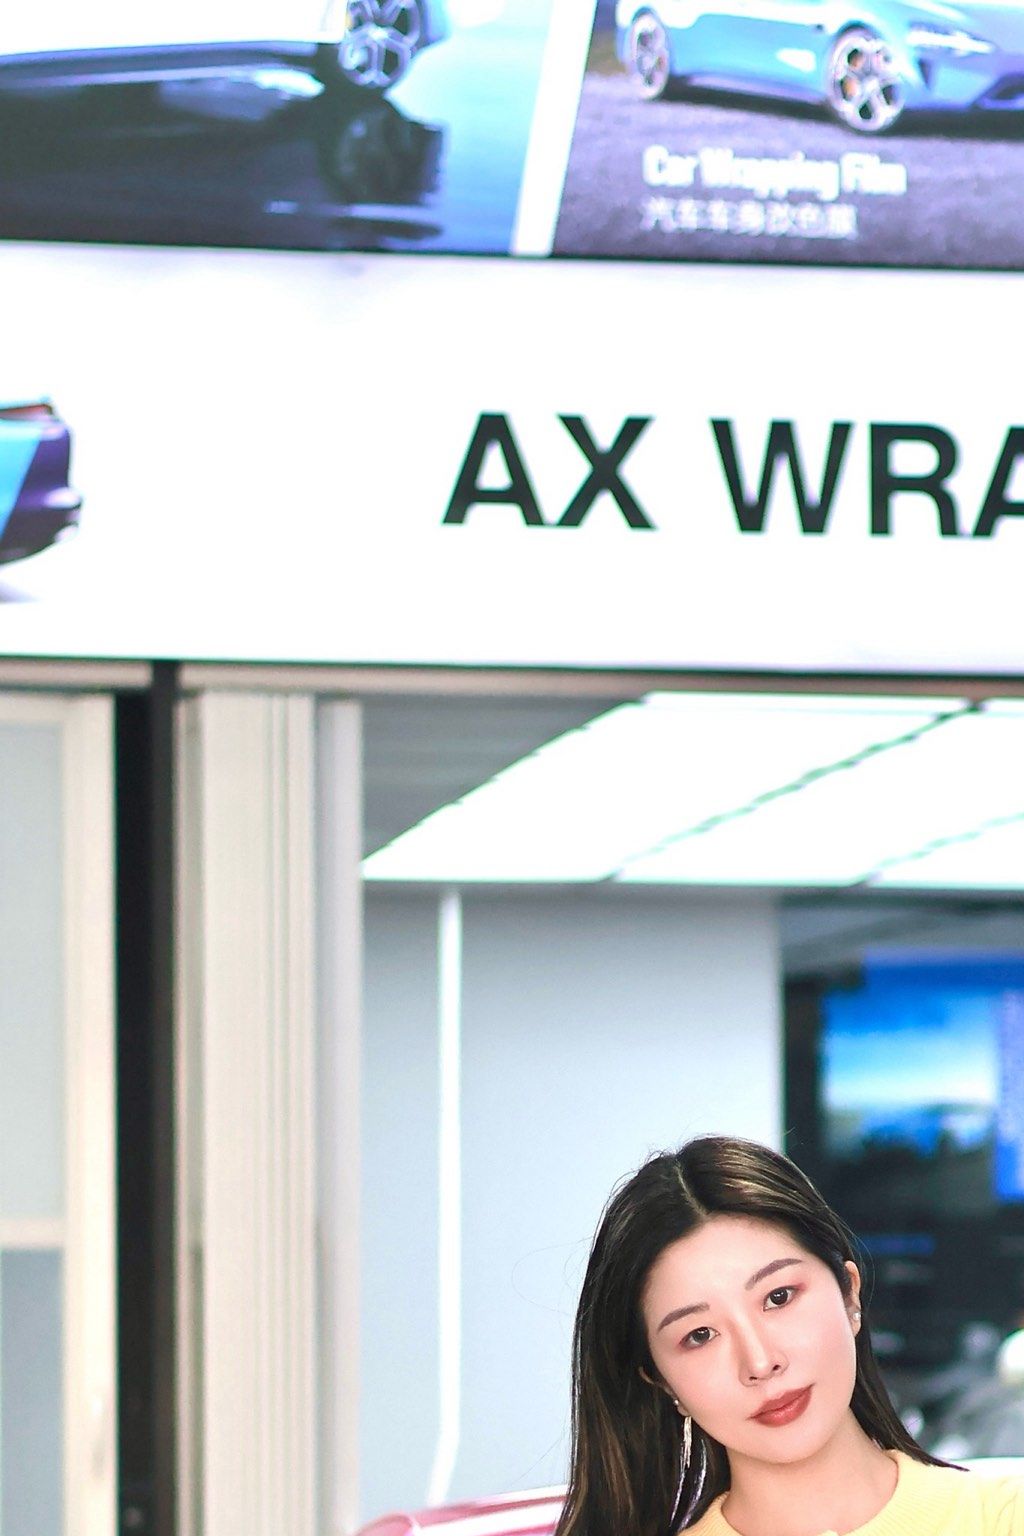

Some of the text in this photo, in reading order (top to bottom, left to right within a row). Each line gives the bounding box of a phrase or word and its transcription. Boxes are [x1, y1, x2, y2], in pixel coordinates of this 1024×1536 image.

[643, 145, 696, 187] Car
[841, 152, 907, 196] Film
[442, 412, 655, 531] AX
